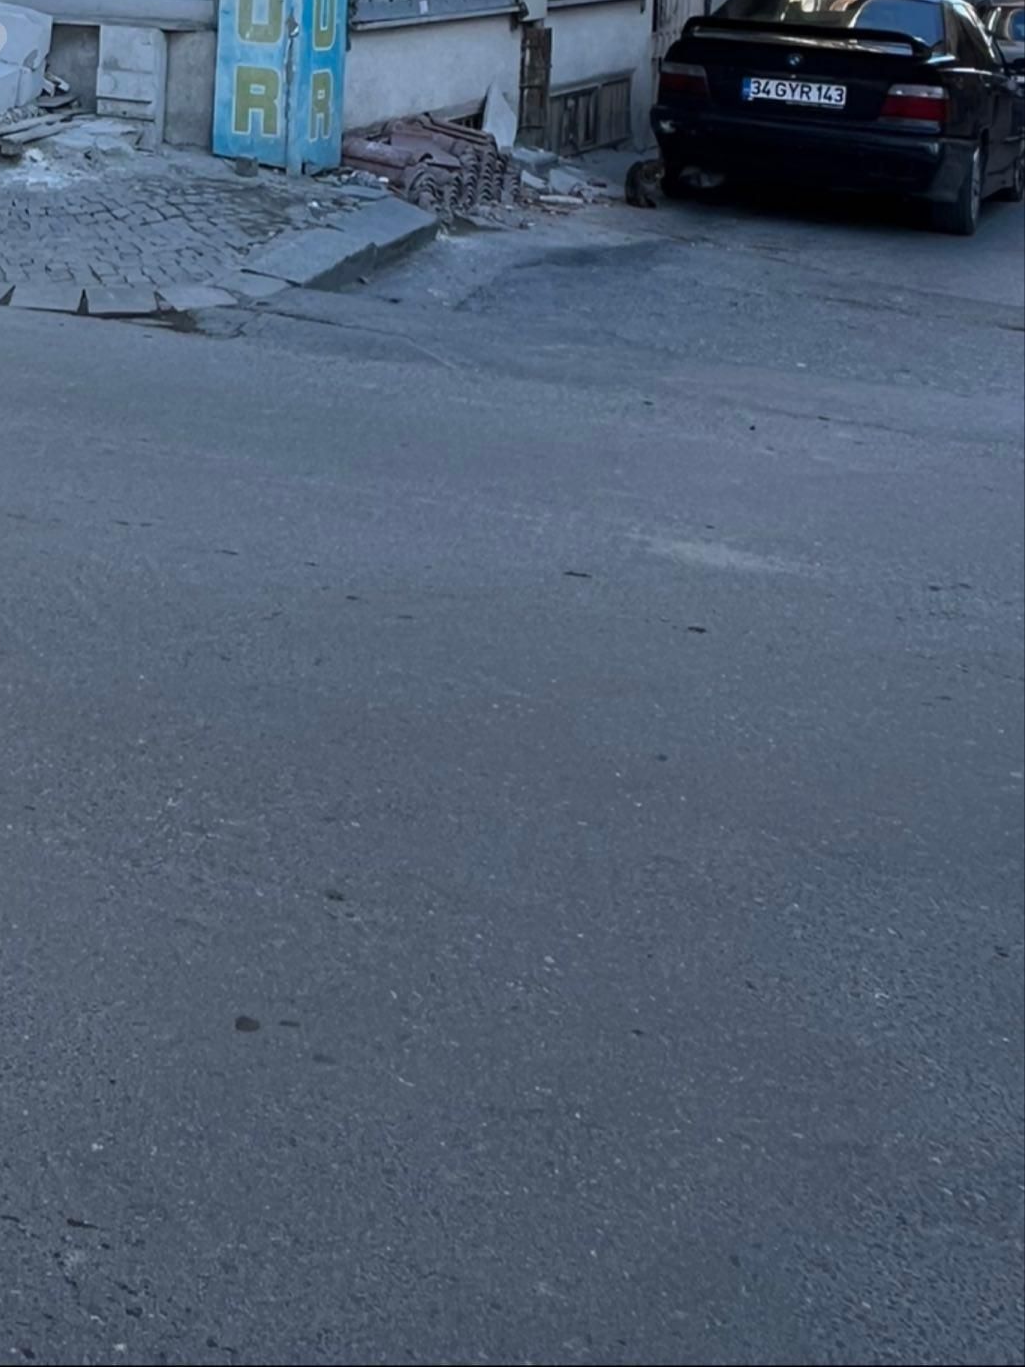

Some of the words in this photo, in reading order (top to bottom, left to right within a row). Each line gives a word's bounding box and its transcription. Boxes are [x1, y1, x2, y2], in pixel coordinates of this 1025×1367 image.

[751, 80, 771, 97] 34
[775, 82, 812, 101] GYR
[817, 84, 845, 103] 143
